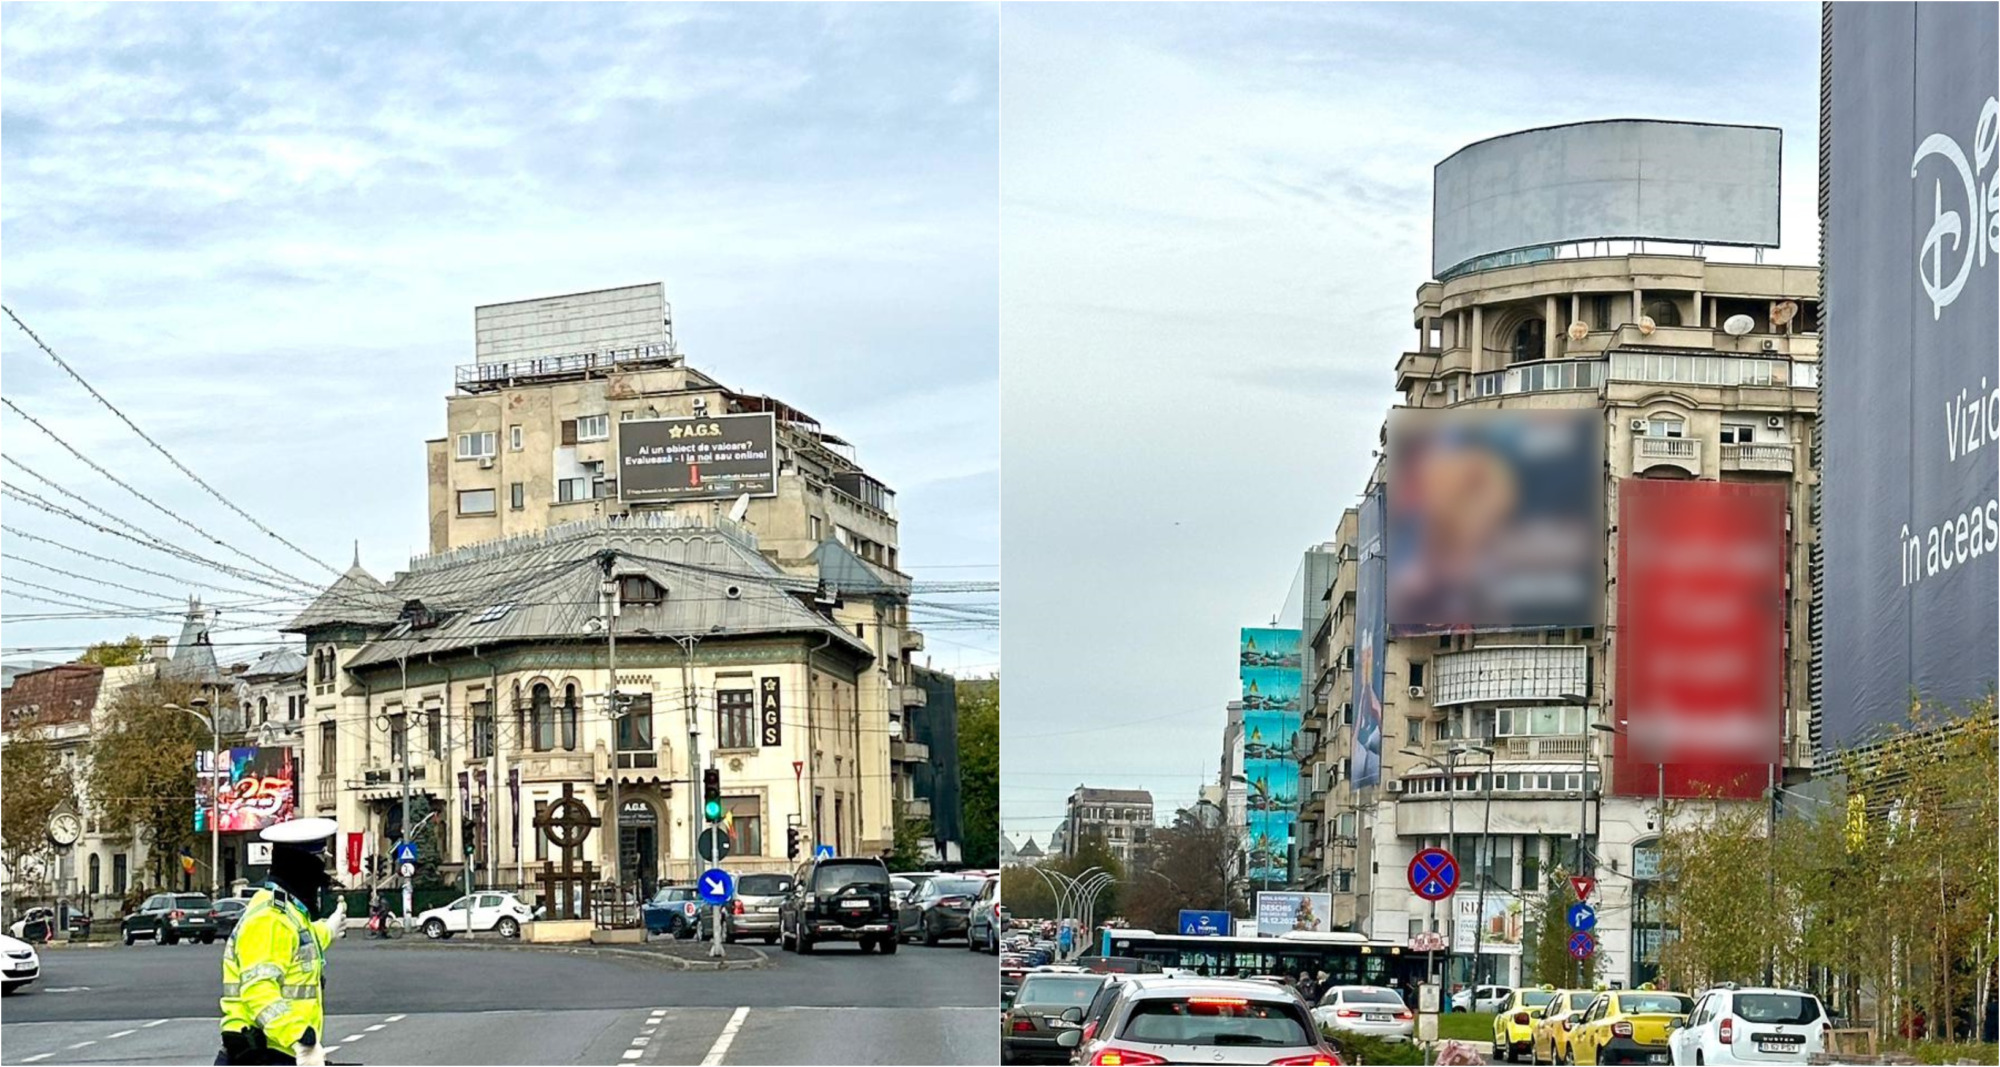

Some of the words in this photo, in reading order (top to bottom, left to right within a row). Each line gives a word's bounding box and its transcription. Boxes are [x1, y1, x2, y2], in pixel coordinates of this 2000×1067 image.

[683, 423, 722, 437] A.G.S.
[639, 446, 649, 455] Ai
[666, 444, 695, 453] obiect
[698, 443, 710, 451] de
[712, 441, 753, 451] valoare?
[698, 452, 712, 460] noi
[715, 452, 732, 460] sau
[734, 450, 767, 460] online!
[1901, 523, 1920, 587] în
[1927, 499, 1998, 577] aceas
[765, 694, 777, 744] AGS
[229, 776, 293, 817] 25
